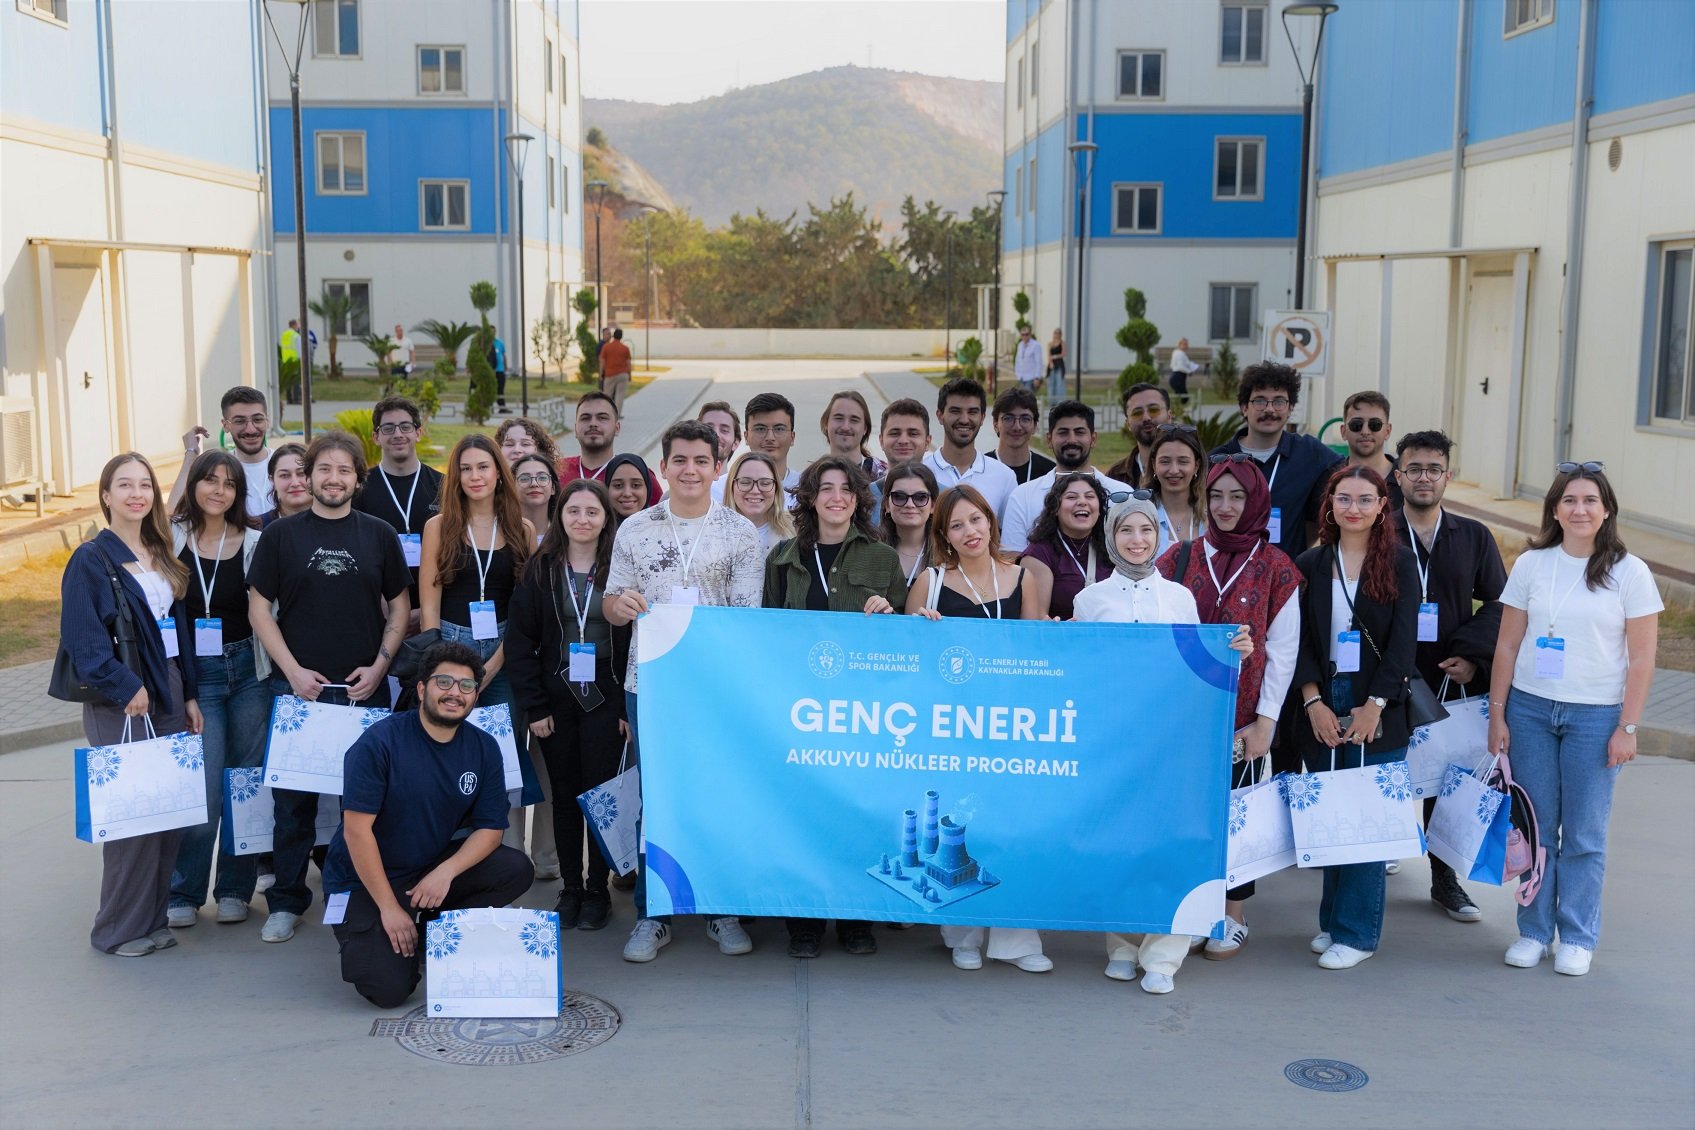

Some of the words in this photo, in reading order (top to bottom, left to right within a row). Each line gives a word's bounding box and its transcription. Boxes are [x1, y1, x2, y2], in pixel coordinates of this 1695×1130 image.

[1285, 327, 1311, 359] P
[848, 651, 865, 661] T.C.
[866, 652, 906, 663] GENÇLİK
[908, 654, 920, 663] VE
[993, 658, 1017, 666] ENERJİ
[1019, 659, 1028, 667] VE
[848, 662, 871, 671] SPOR
[873, 663, 920, 673] BAKANLIĞI
[978, 666, 1022, 675] KAYNAKLAR
[1024, 668, 1064, 677] BAKANLIĞI
[790, 697, 918, 747] GENÇ
[931, 699, 1078, 743] ENERJİ
[785, 748, 870, 769] AKKUYU
[875, 749, 961, 772] NÜKLEER
[966, 756, 1080, 777] PROGRAMI
[464, 774, 474, 783] US
[463, 783, 473, 792] PA
